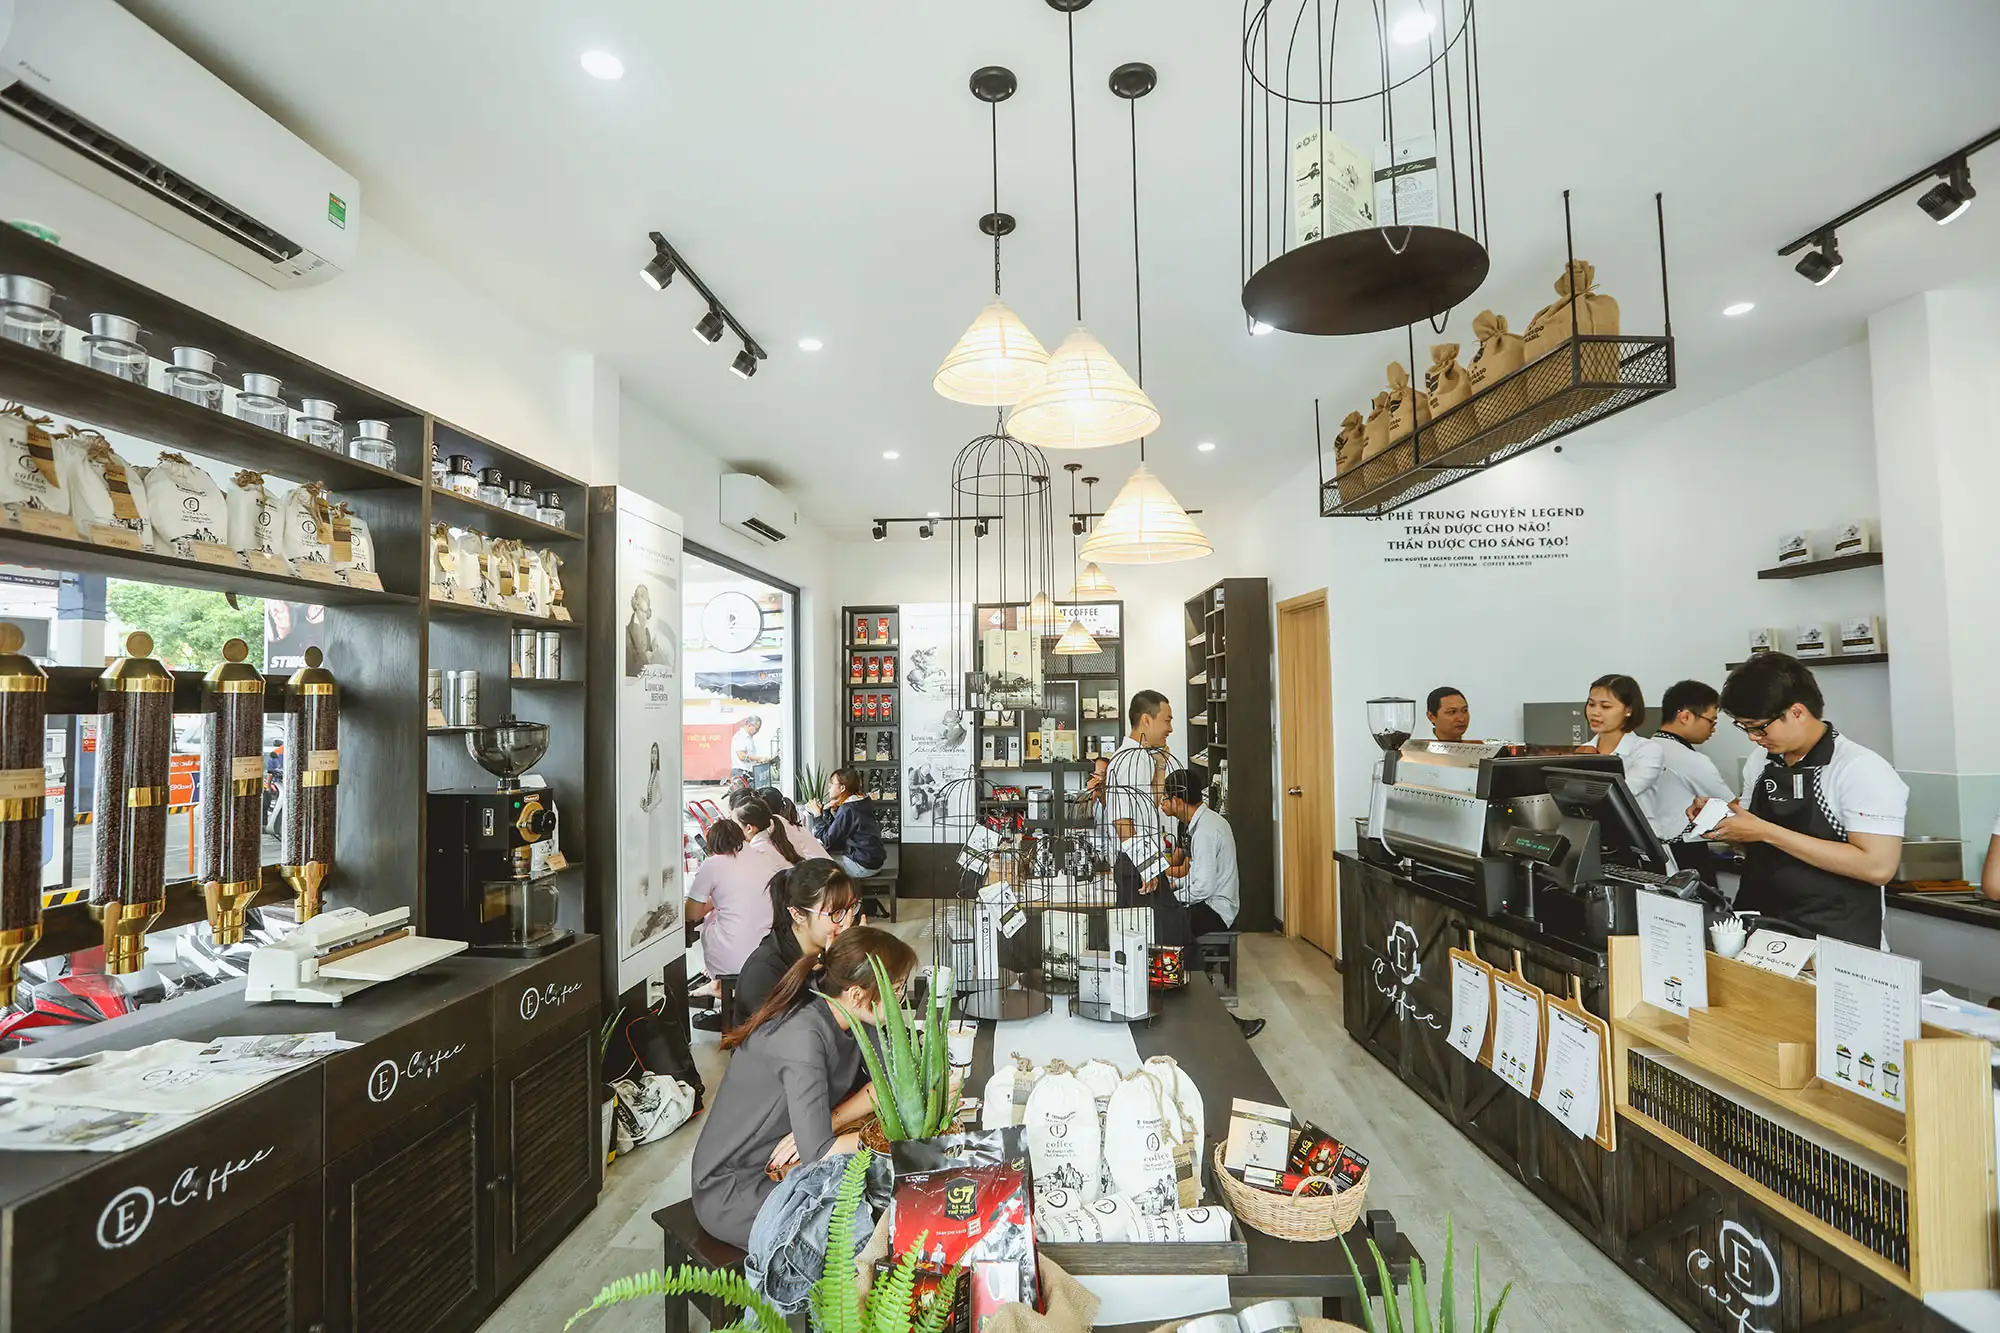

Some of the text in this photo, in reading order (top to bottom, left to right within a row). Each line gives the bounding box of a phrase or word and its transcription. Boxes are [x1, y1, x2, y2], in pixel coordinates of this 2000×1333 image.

[1388, 509, 1414, 521] PHÊ
[1418, 510, 1465, 520] TRUNG
[1470, 507, 1526, 519] NGUYÊN
[1532, 507, 1584, 517] LEGEND
[1486, 524, 1514, 533] CHO
[1518, 521, 1550, 532] NÃO!
[1469, 539, 1498, 549] CHO
[1500, 536, 1535, 547] SÁNG
[1538, 536, 1568, 548] TẠO!
[1069, 607, 1099, 617] COFFEE
